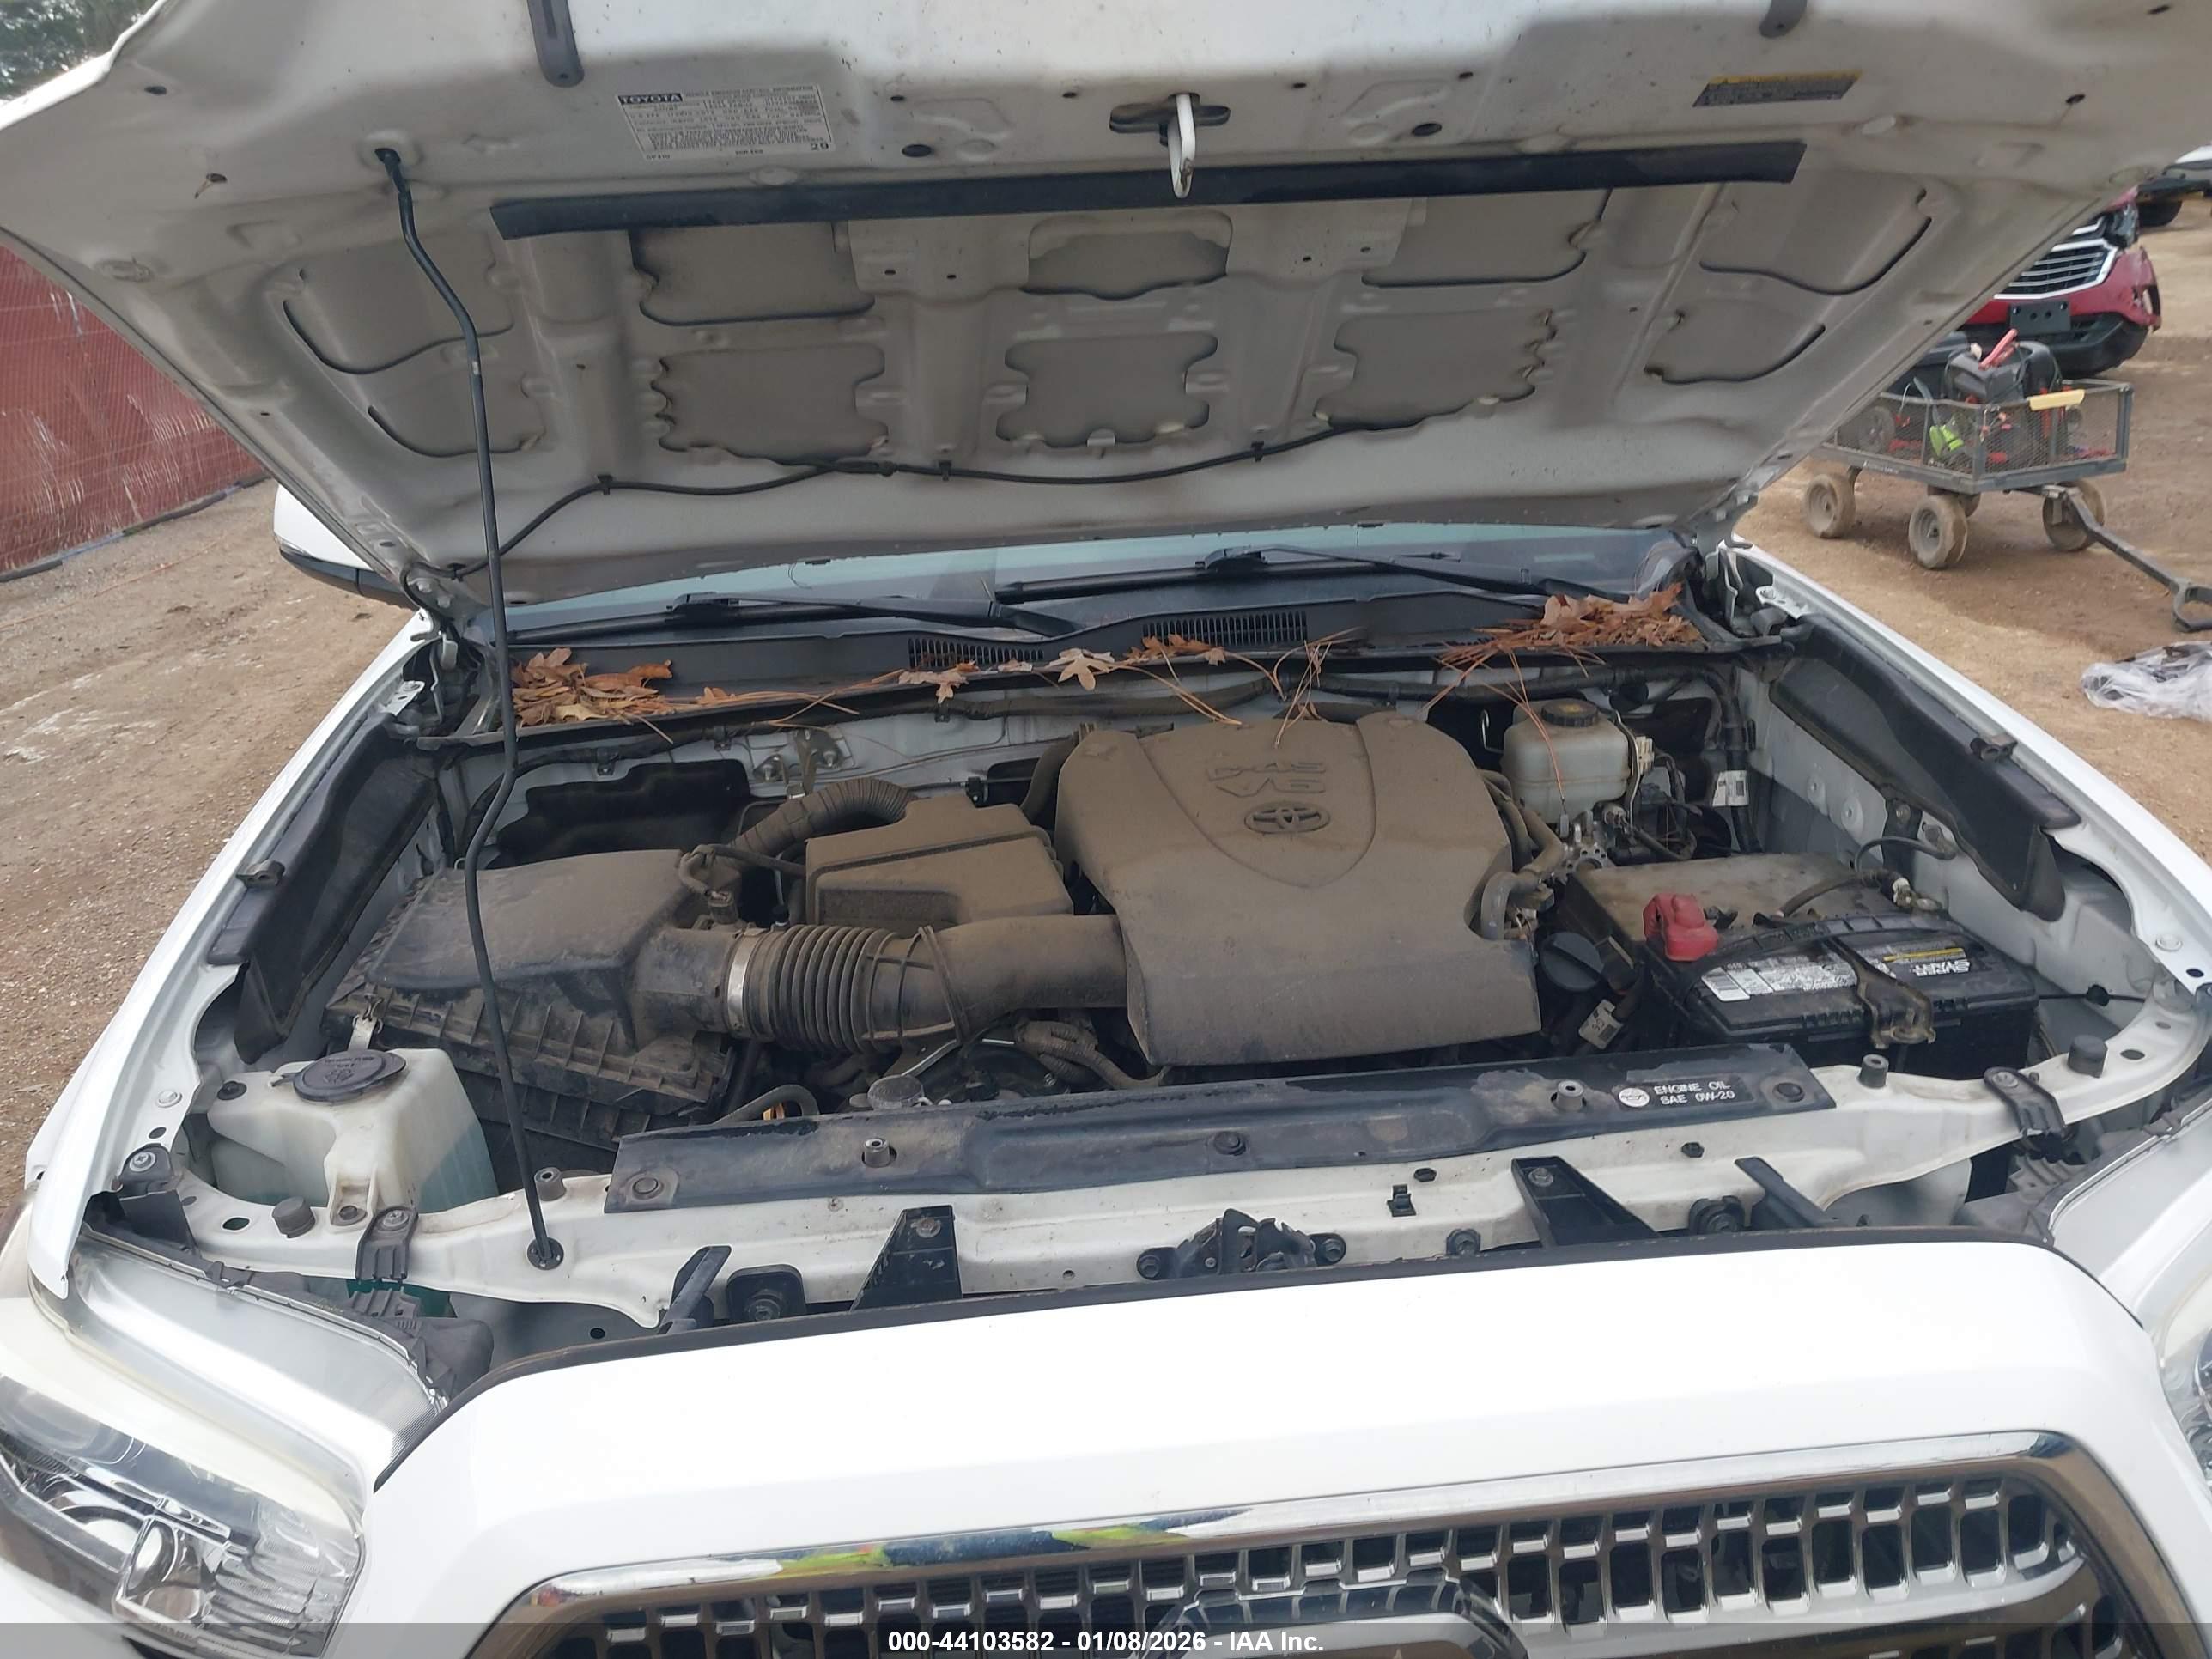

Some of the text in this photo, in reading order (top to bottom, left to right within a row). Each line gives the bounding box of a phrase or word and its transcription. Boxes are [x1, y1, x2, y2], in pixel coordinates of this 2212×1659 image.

[619, 93, 682, 104] TOYOTA
[1654, 1081, 1731, 1095] ENGINE OIL
[1660, 1090, 1735, 1105] SAE 0W-20
